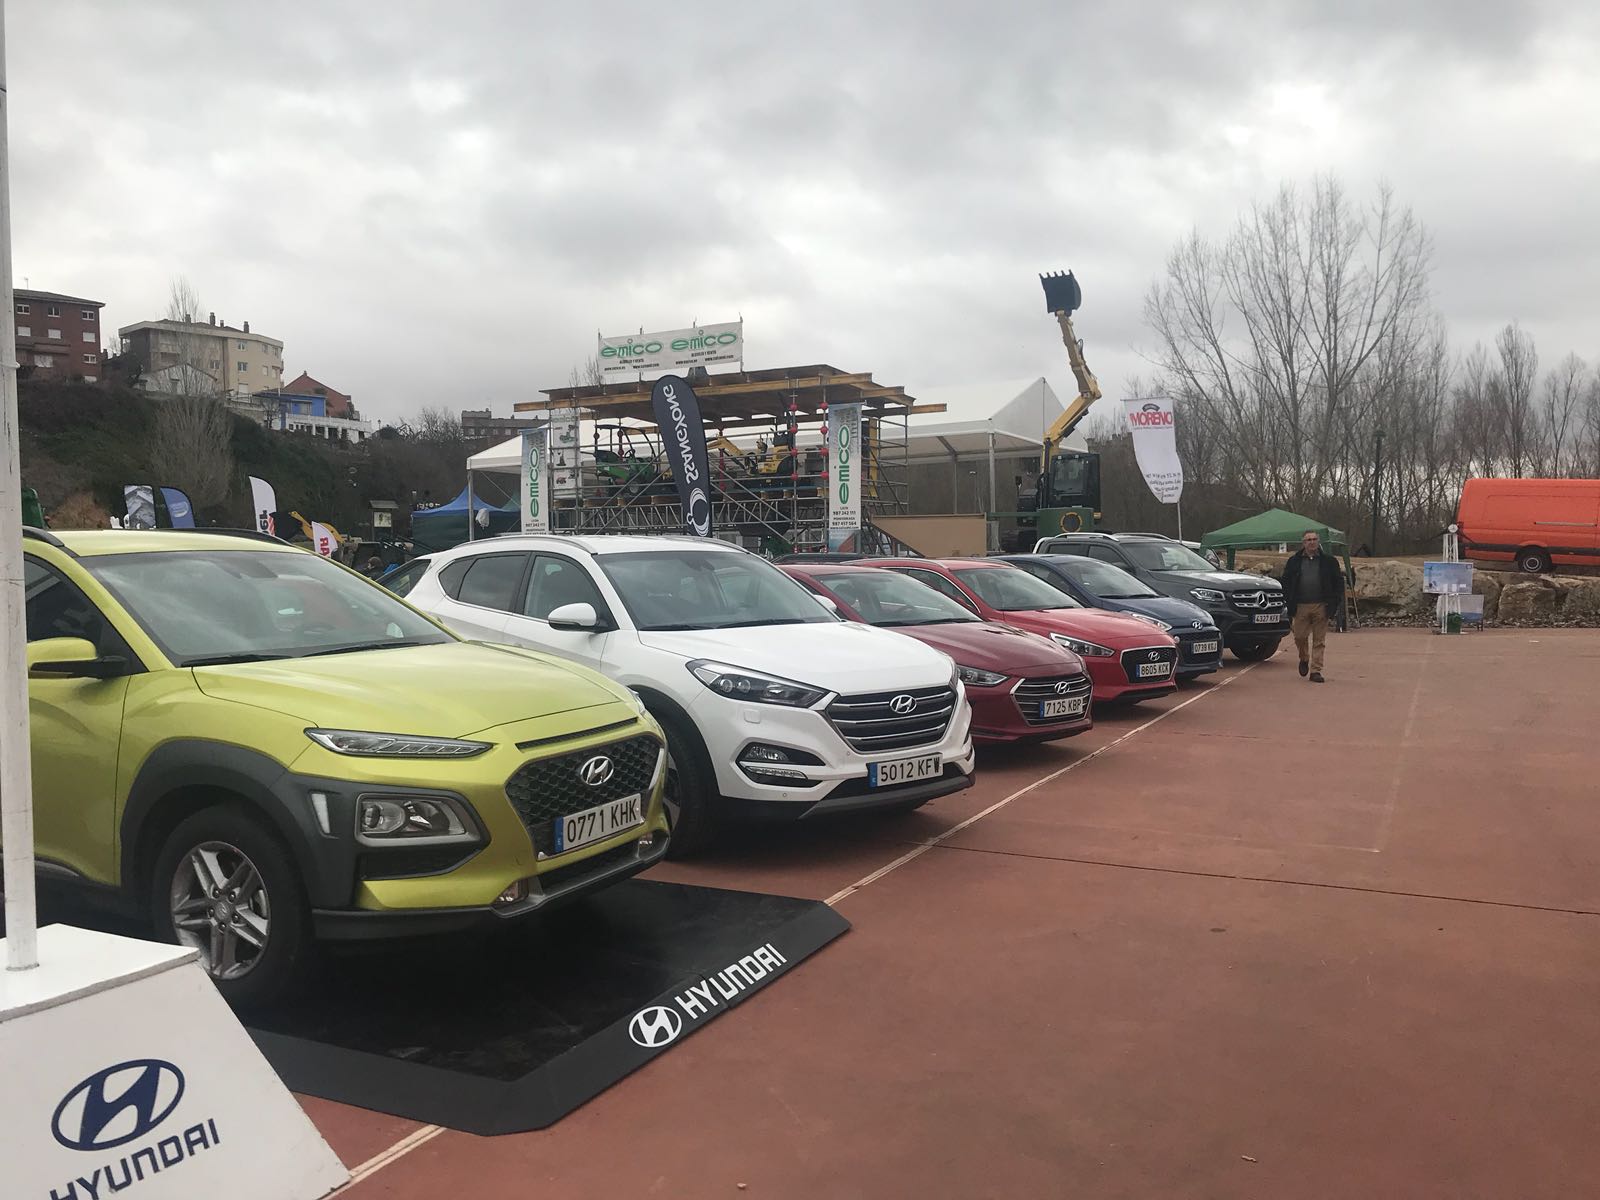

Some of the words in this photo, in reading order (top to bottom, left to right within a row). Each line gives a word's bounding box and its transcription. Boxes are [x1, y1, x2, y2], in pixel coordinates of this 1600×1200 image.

[601, 338, 663, 358] emico
[671, 329, 737, 350] emico
[1129, 411, 1173, 426] MORENO
[833, 426, 850, 505] emico
[525, 448, 540, 518] emico
[1141, 665, 1158, 676] 8605
[1046, 701, 1067, 715] 7125
[881, 762, 914, 782] 5012
[918, 756, 941, 777] KFW
[567, 809, 604, 843] 0771
[611, 798, 637, 829] KHK
[674, 943, 787, 1020] HYUNDAI
